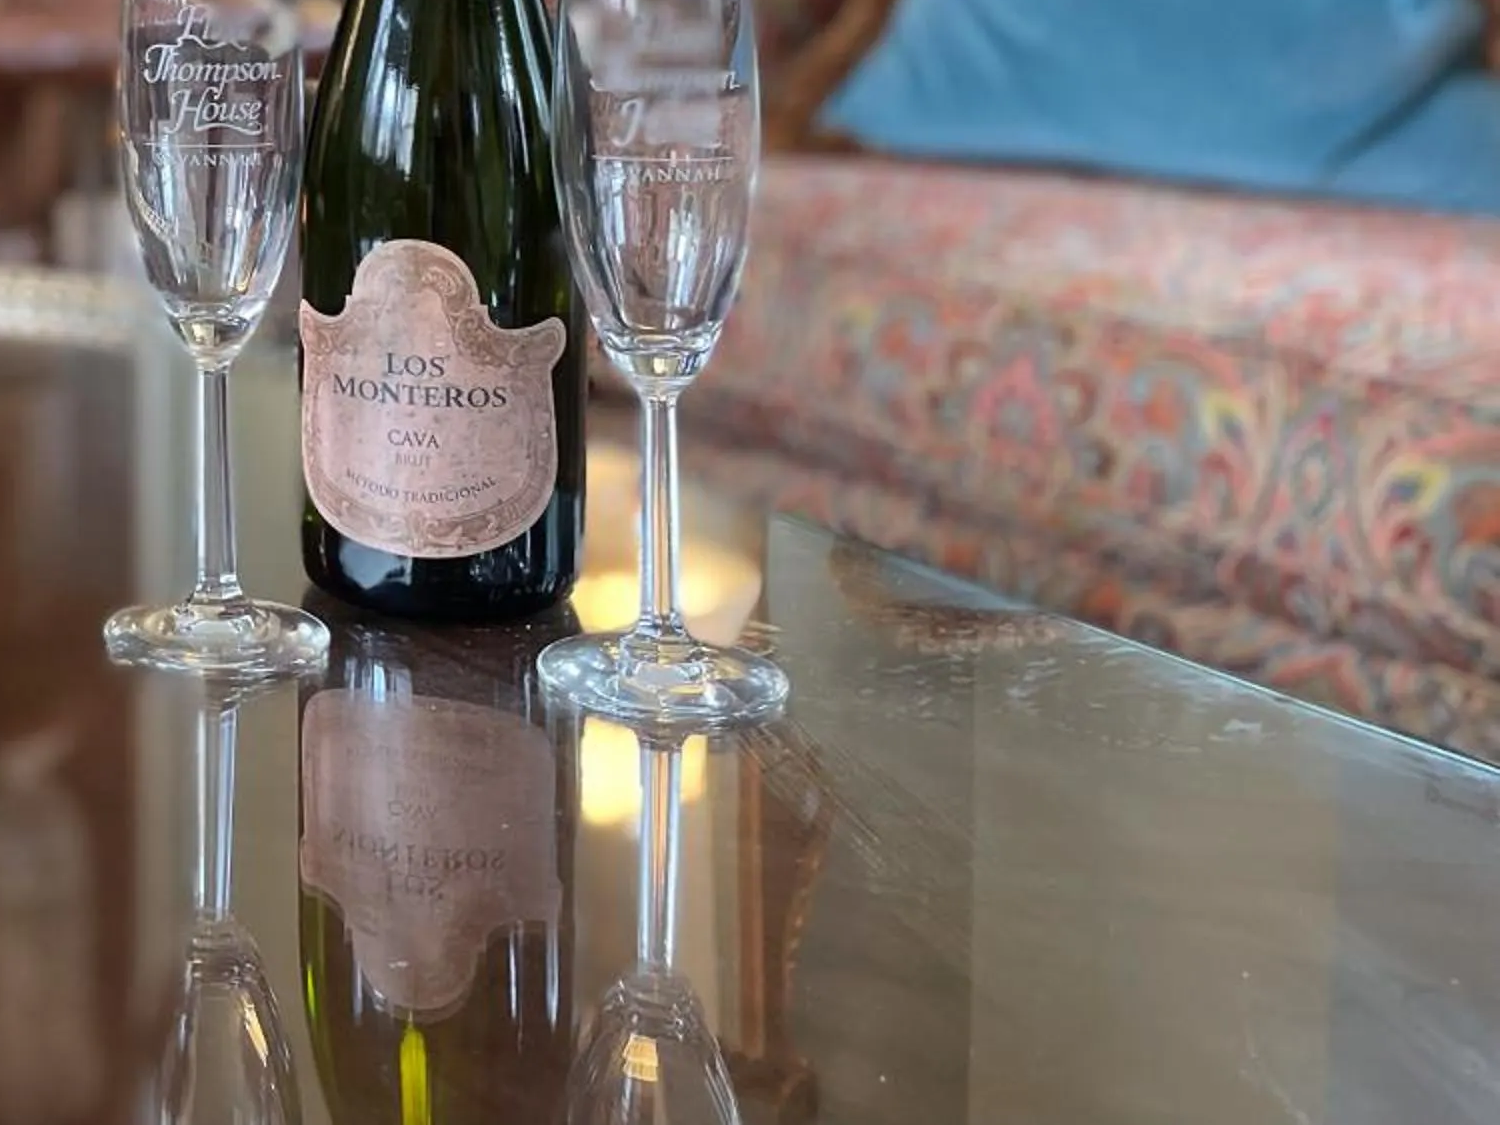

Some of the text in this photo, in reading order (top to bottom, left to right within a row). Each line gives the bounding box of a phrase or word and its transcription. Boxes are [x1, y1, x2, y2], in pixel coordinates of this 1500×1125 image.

[144, 44, 282, 100] Thompson
[164, 86, 263, 135] House
[387, 352, 446, 377] LOS
[333, 374, 507, 408] MONTEROS
[387, 429, 440, 449] CAVA
[403, 476, 498, 504] TRADICIONAL
